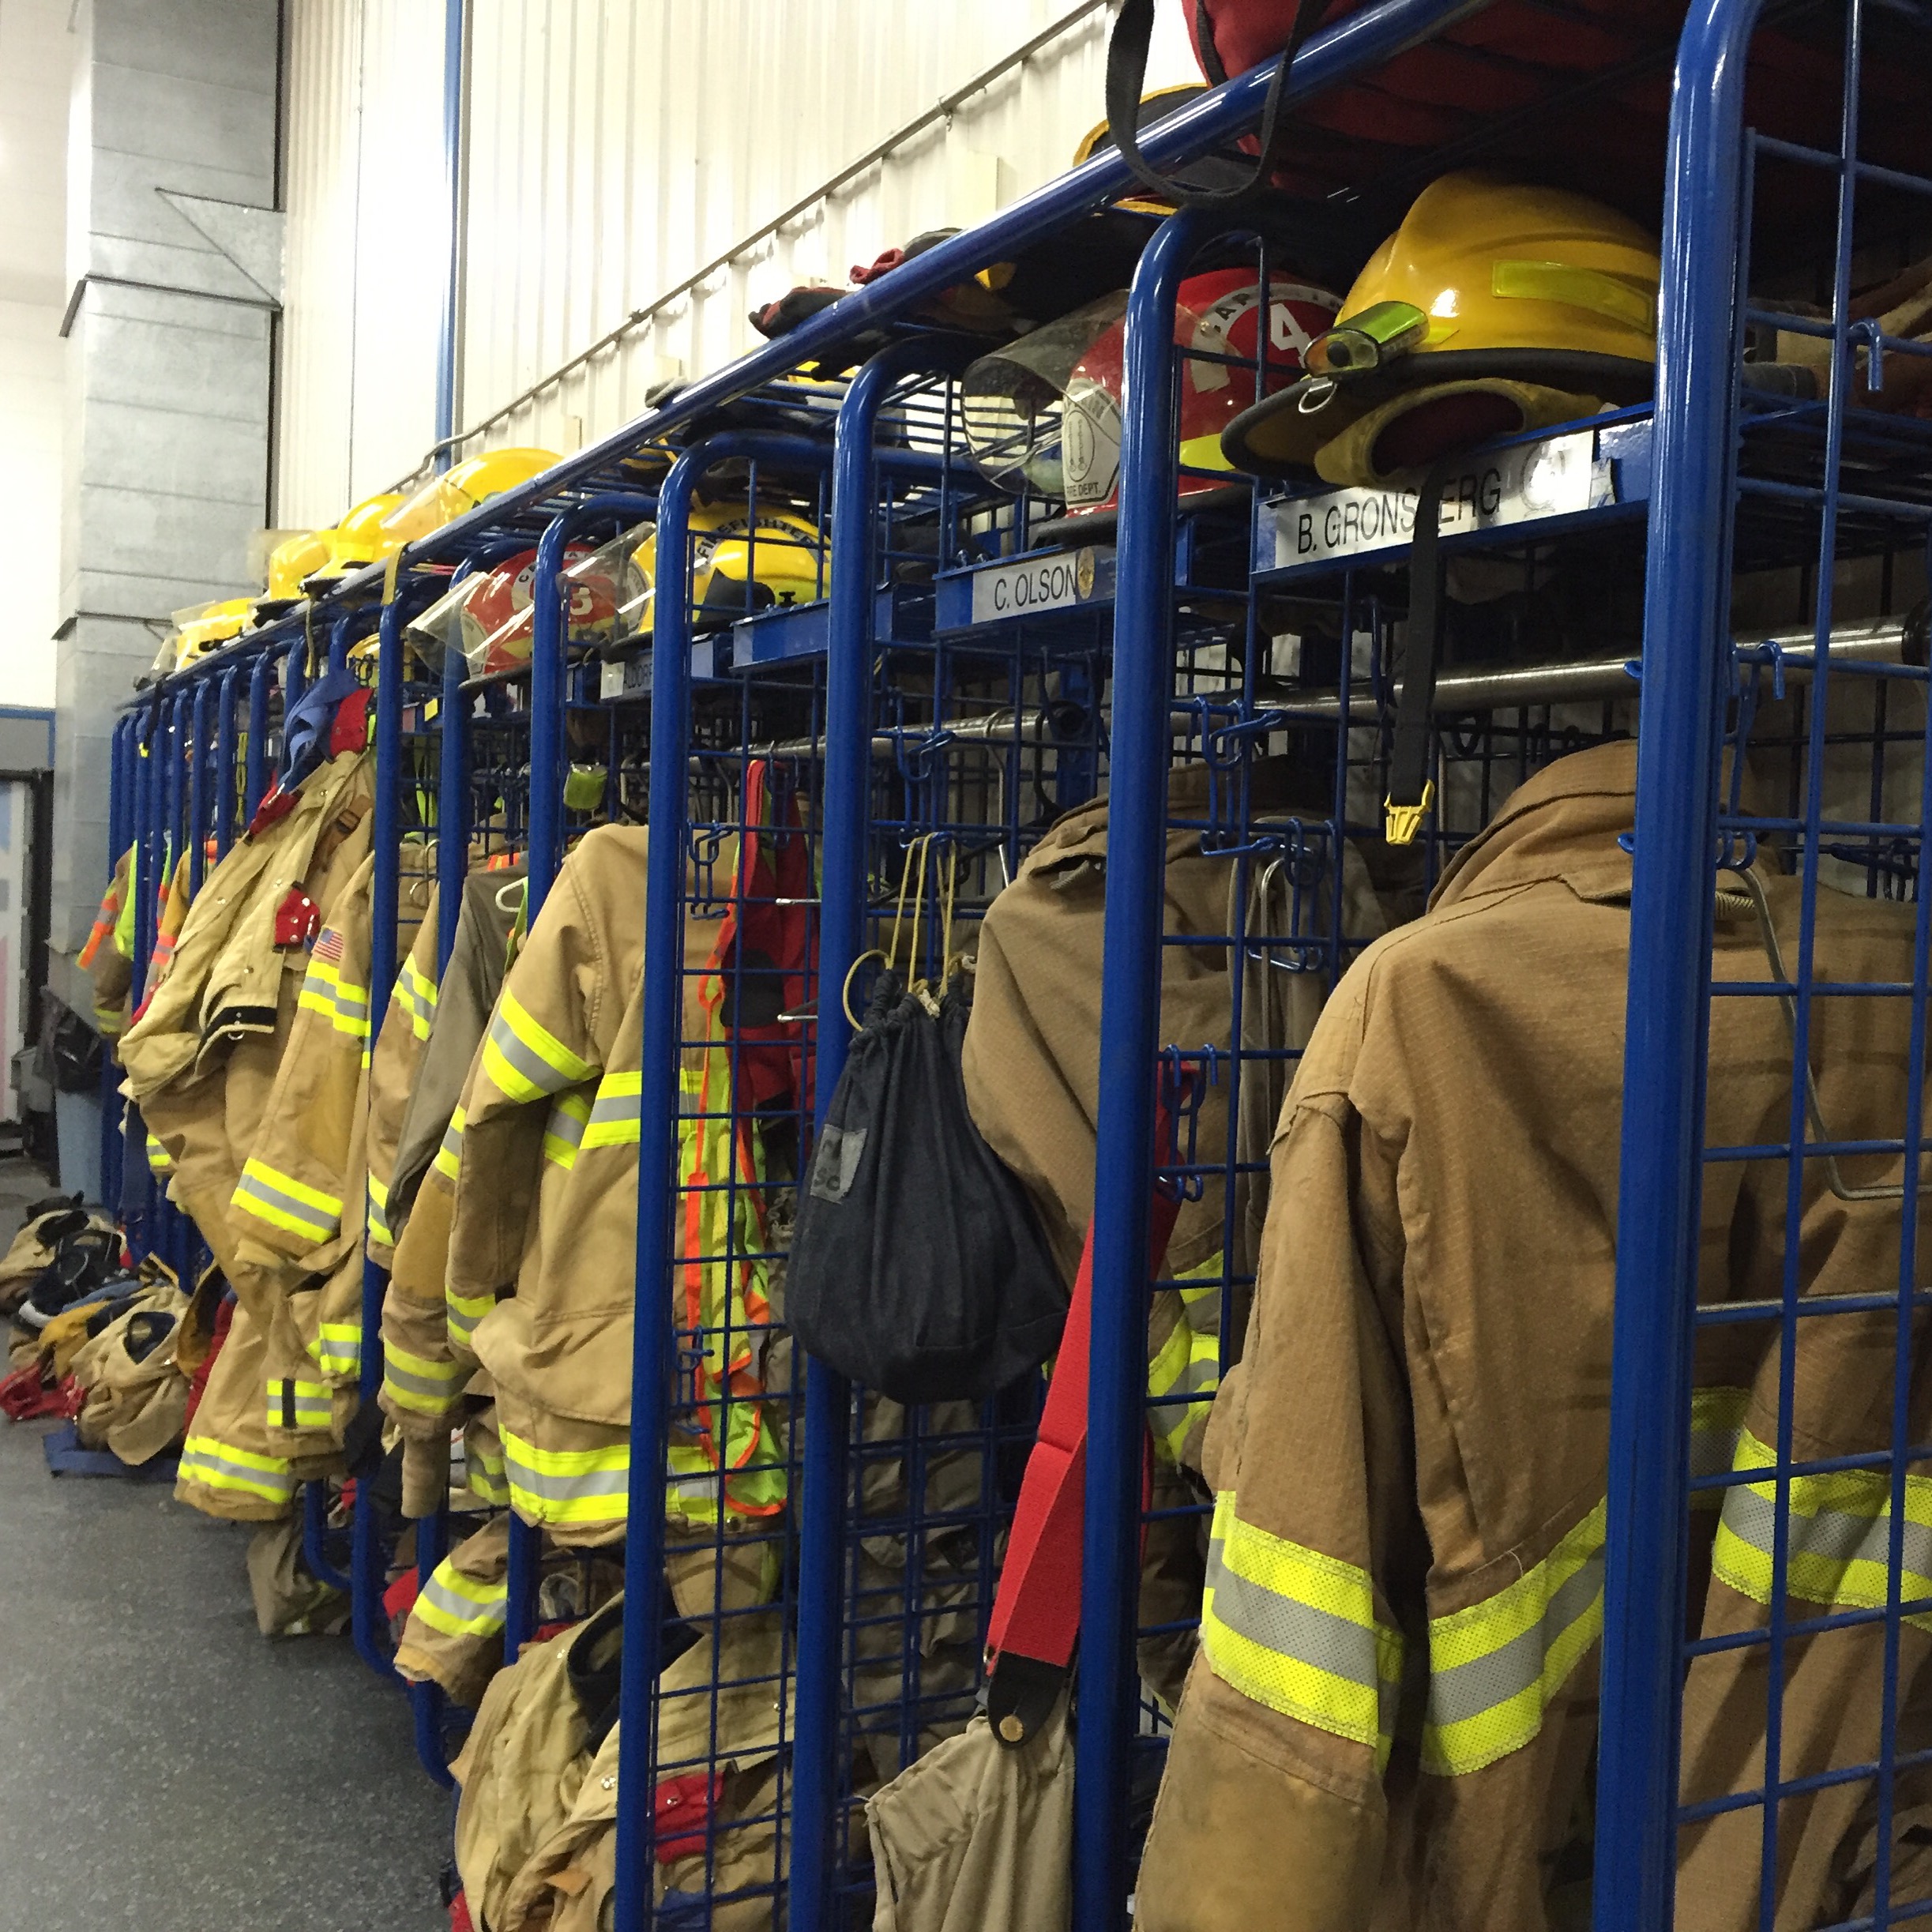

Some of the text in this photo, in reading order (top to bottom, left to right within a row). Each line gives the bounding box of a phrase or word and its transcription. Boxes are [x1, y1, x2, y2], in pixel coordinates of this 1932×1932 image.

[1271, 303, 1312, 369] 4
[1298, 468, 1502, 554] B. GRONSERG
[994, 564, 1077, 611] C. OLSON
